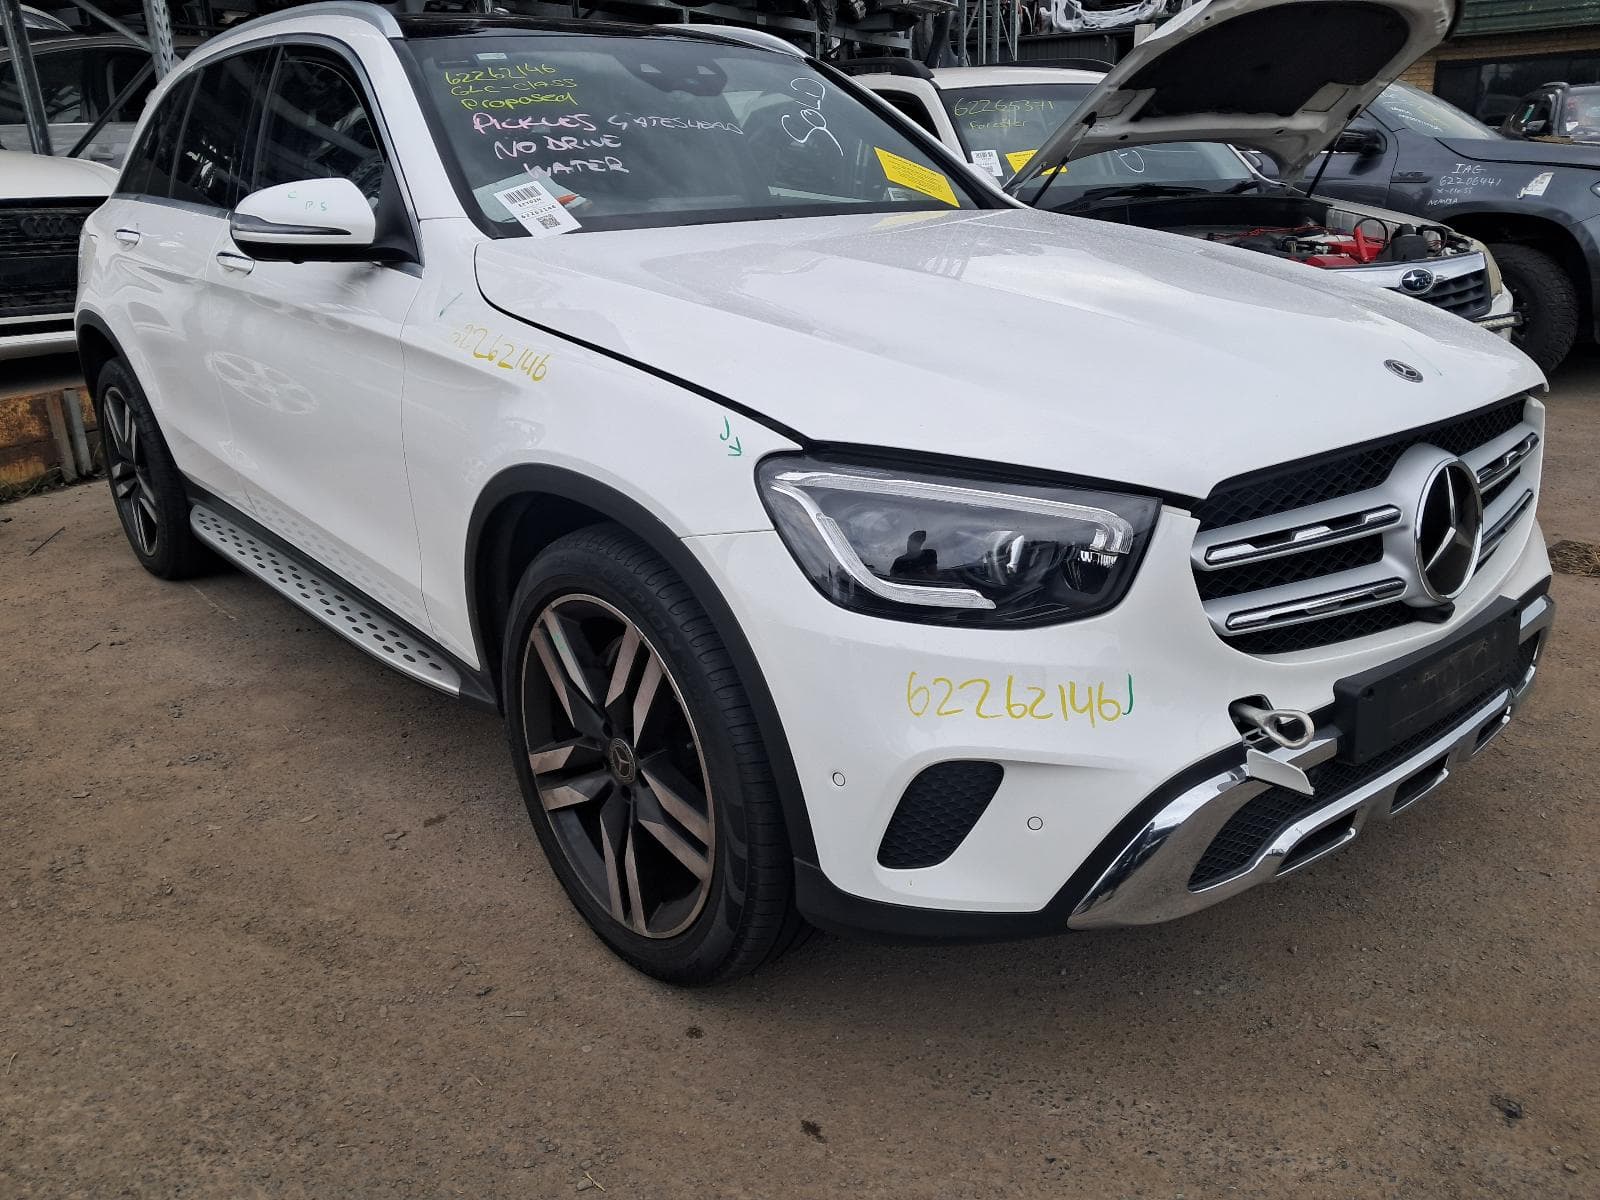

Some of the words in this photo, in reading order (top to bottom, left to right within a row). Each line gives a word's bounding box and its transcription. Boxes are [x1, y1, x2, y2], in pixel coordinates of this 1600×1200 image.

[445, 63, 556, 85] 62262146
[473, 112, 597, 134] PICKLES
[494, 140, 537, 160] NO
[542, 134, 622, 151] DRIVE
[523, 156, 629, 179] WATER
[906, 671, 1122, 729] 62262146
